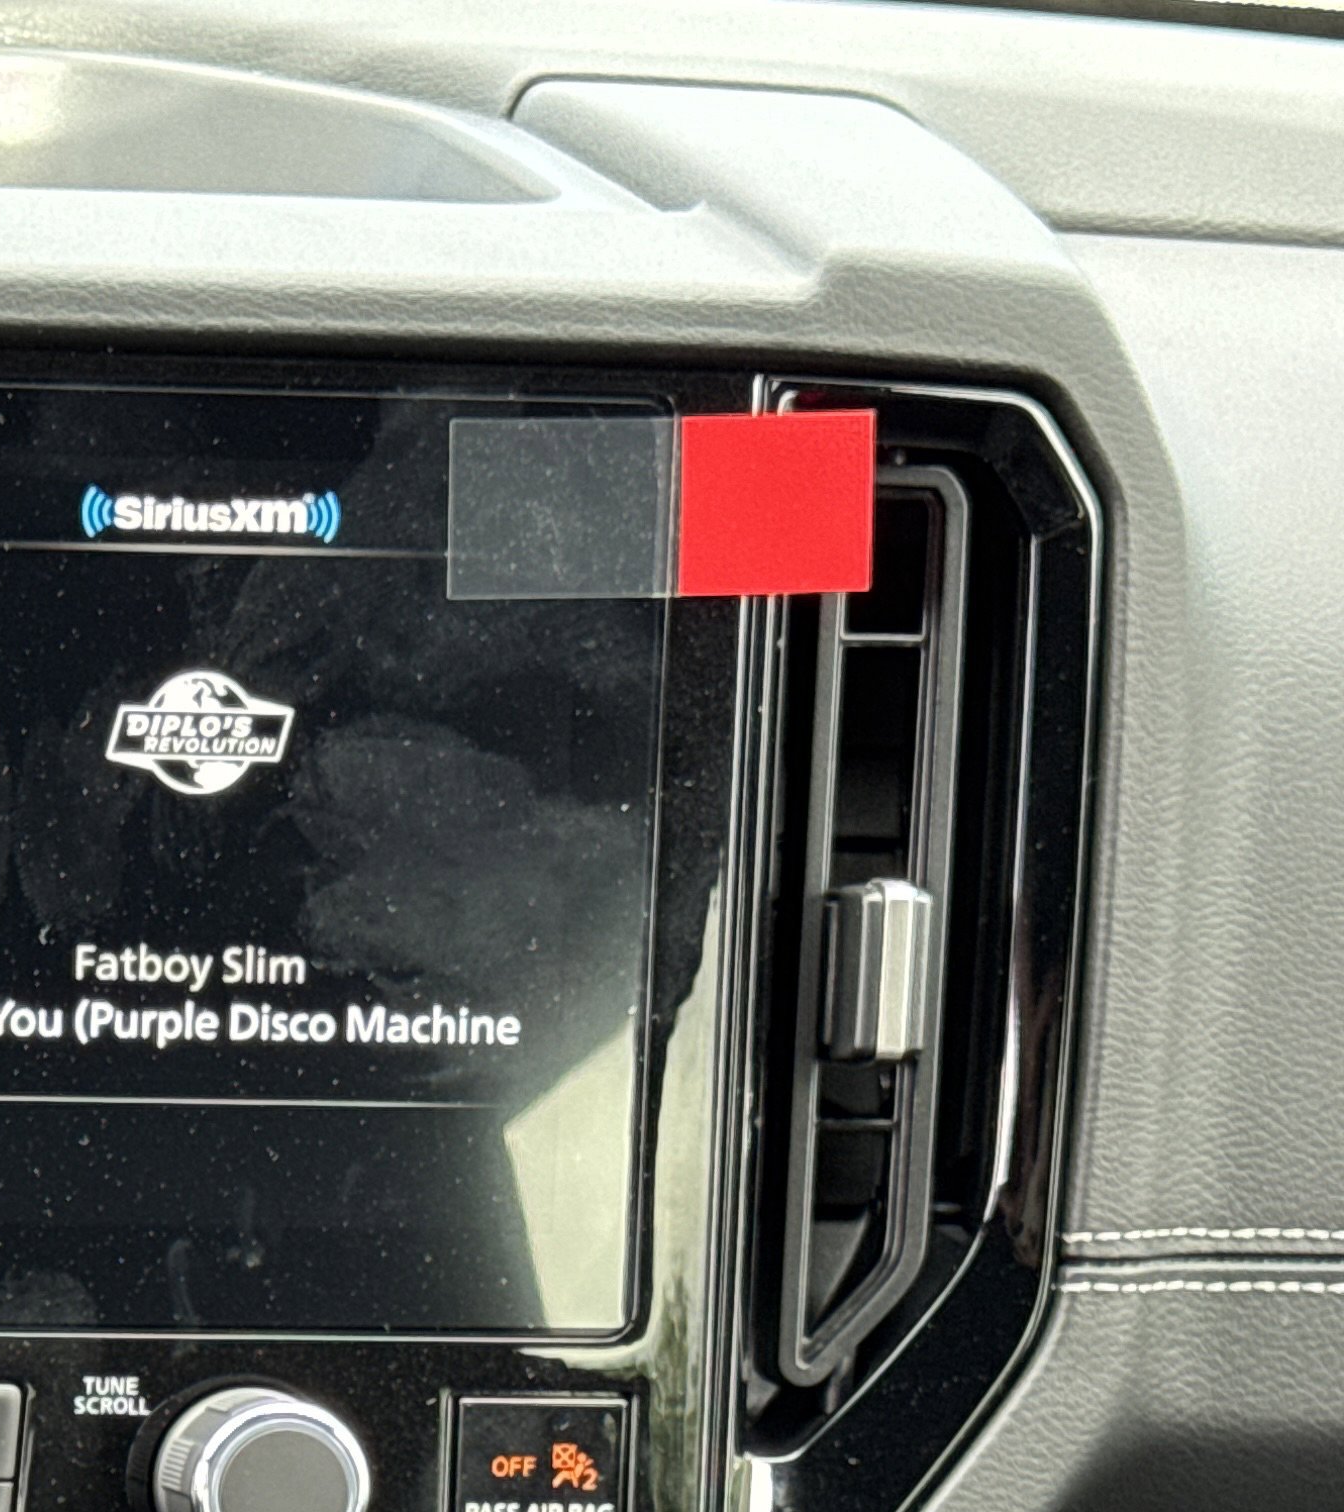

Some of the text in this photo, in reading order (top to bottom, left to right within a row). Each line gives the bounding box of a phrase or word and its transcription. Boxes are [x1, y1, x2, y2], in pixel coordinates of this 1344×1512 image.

[126, 715, 253, 738] DIPLO'S
[143, 736, 276, 755] REVOLUTION
[74, 944, 305, 992] Fatboy Slim
[74, 998, 218, 1048] (Purple
[229, 1002, 336, 1043] Disco
[345, 1004, 521, 1046] Machine
[83, 1376, 139, 1396] TUNE
[73, 1396, 151, 1417] SCROLL
[490, 1455, 537, 1478] OFF
